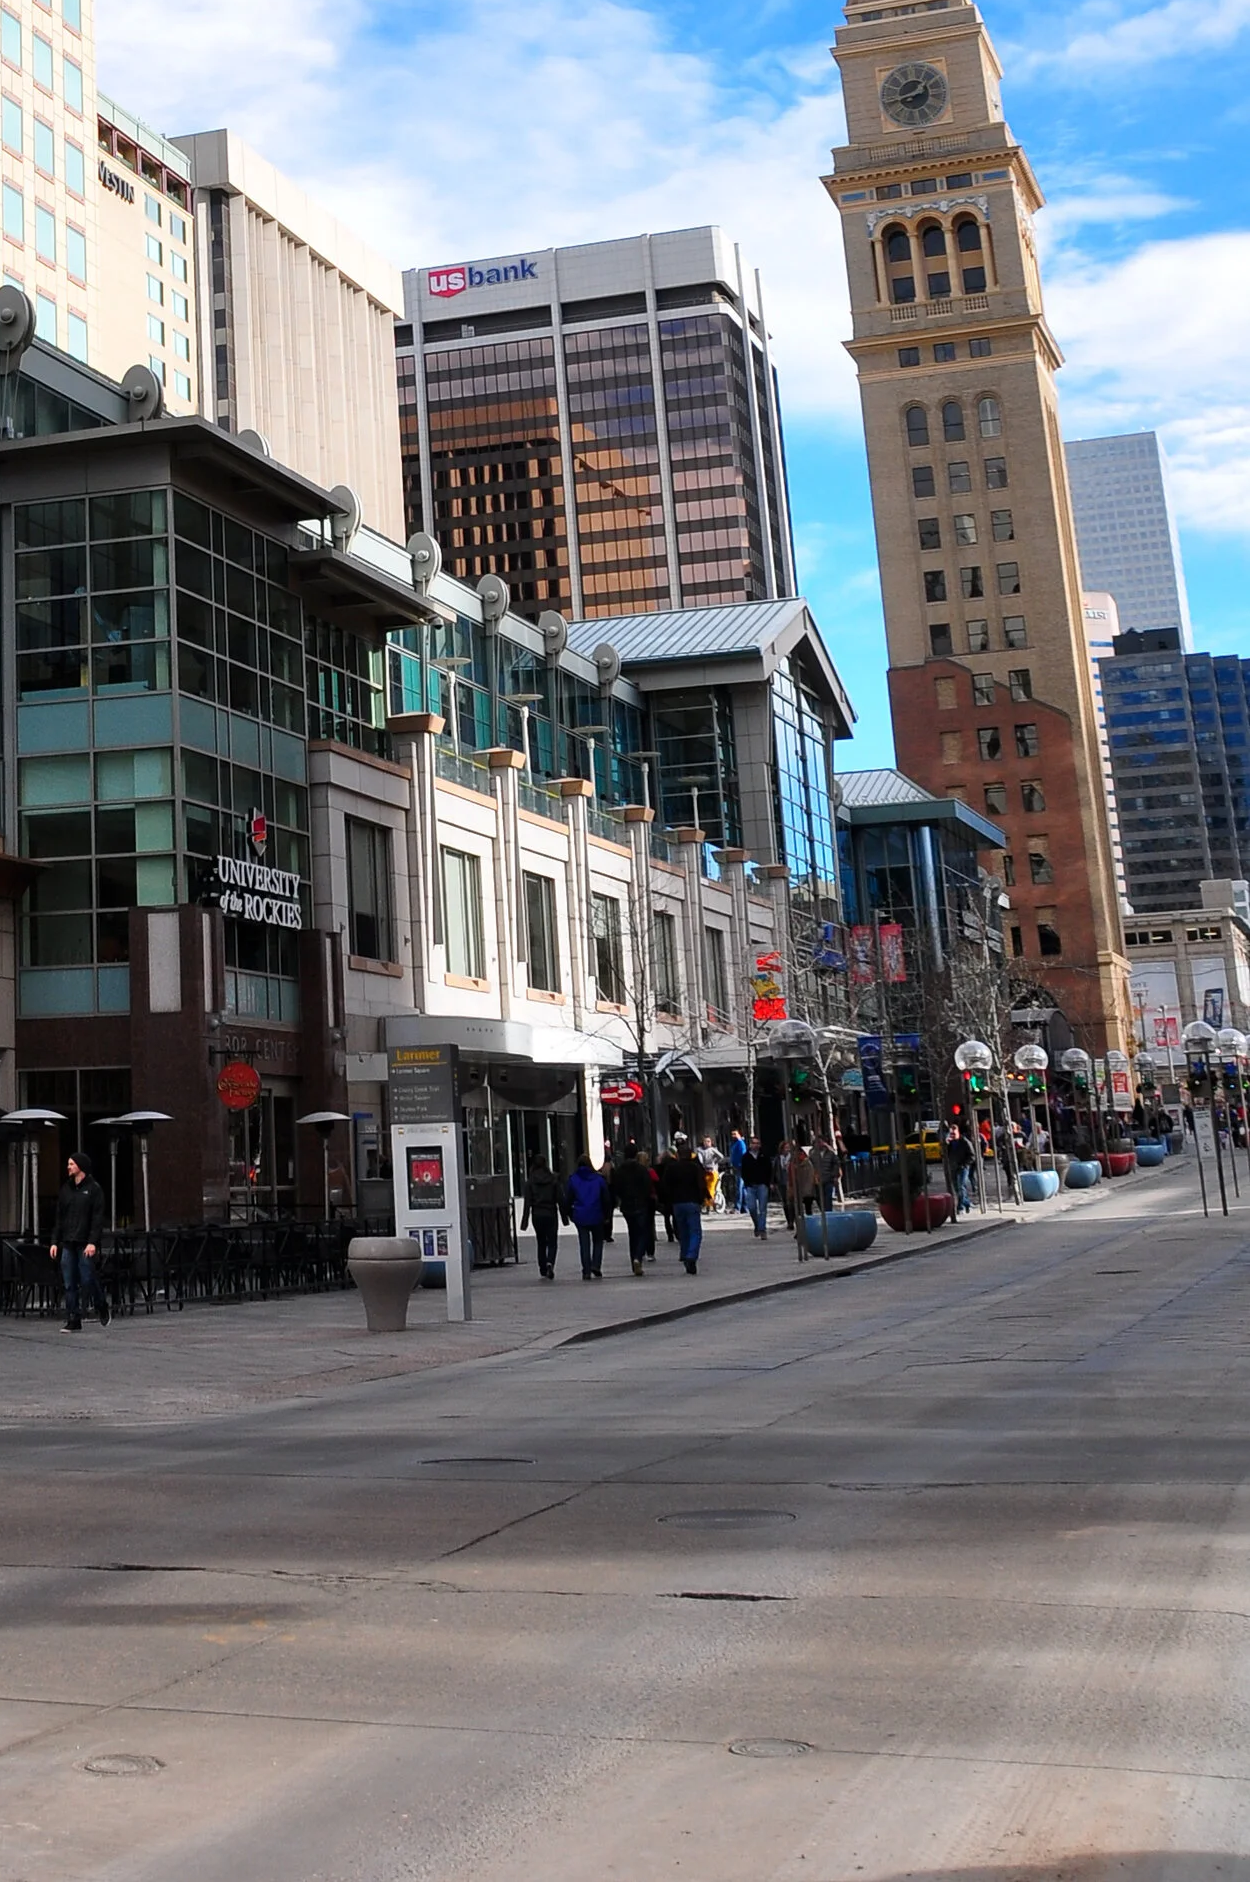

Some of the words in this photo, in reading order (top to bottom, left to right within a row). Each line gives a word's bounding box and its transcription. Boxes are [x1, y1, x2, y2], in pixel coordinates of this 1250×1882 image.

[217, 855, 300, 898] UNIVERSITY
[219, 889, 231, 914] of
[229, 891, 243, 912] the
[243, 892, 302, 930] ROCKIES
[396, 1048, 441, 1062] Larimer
